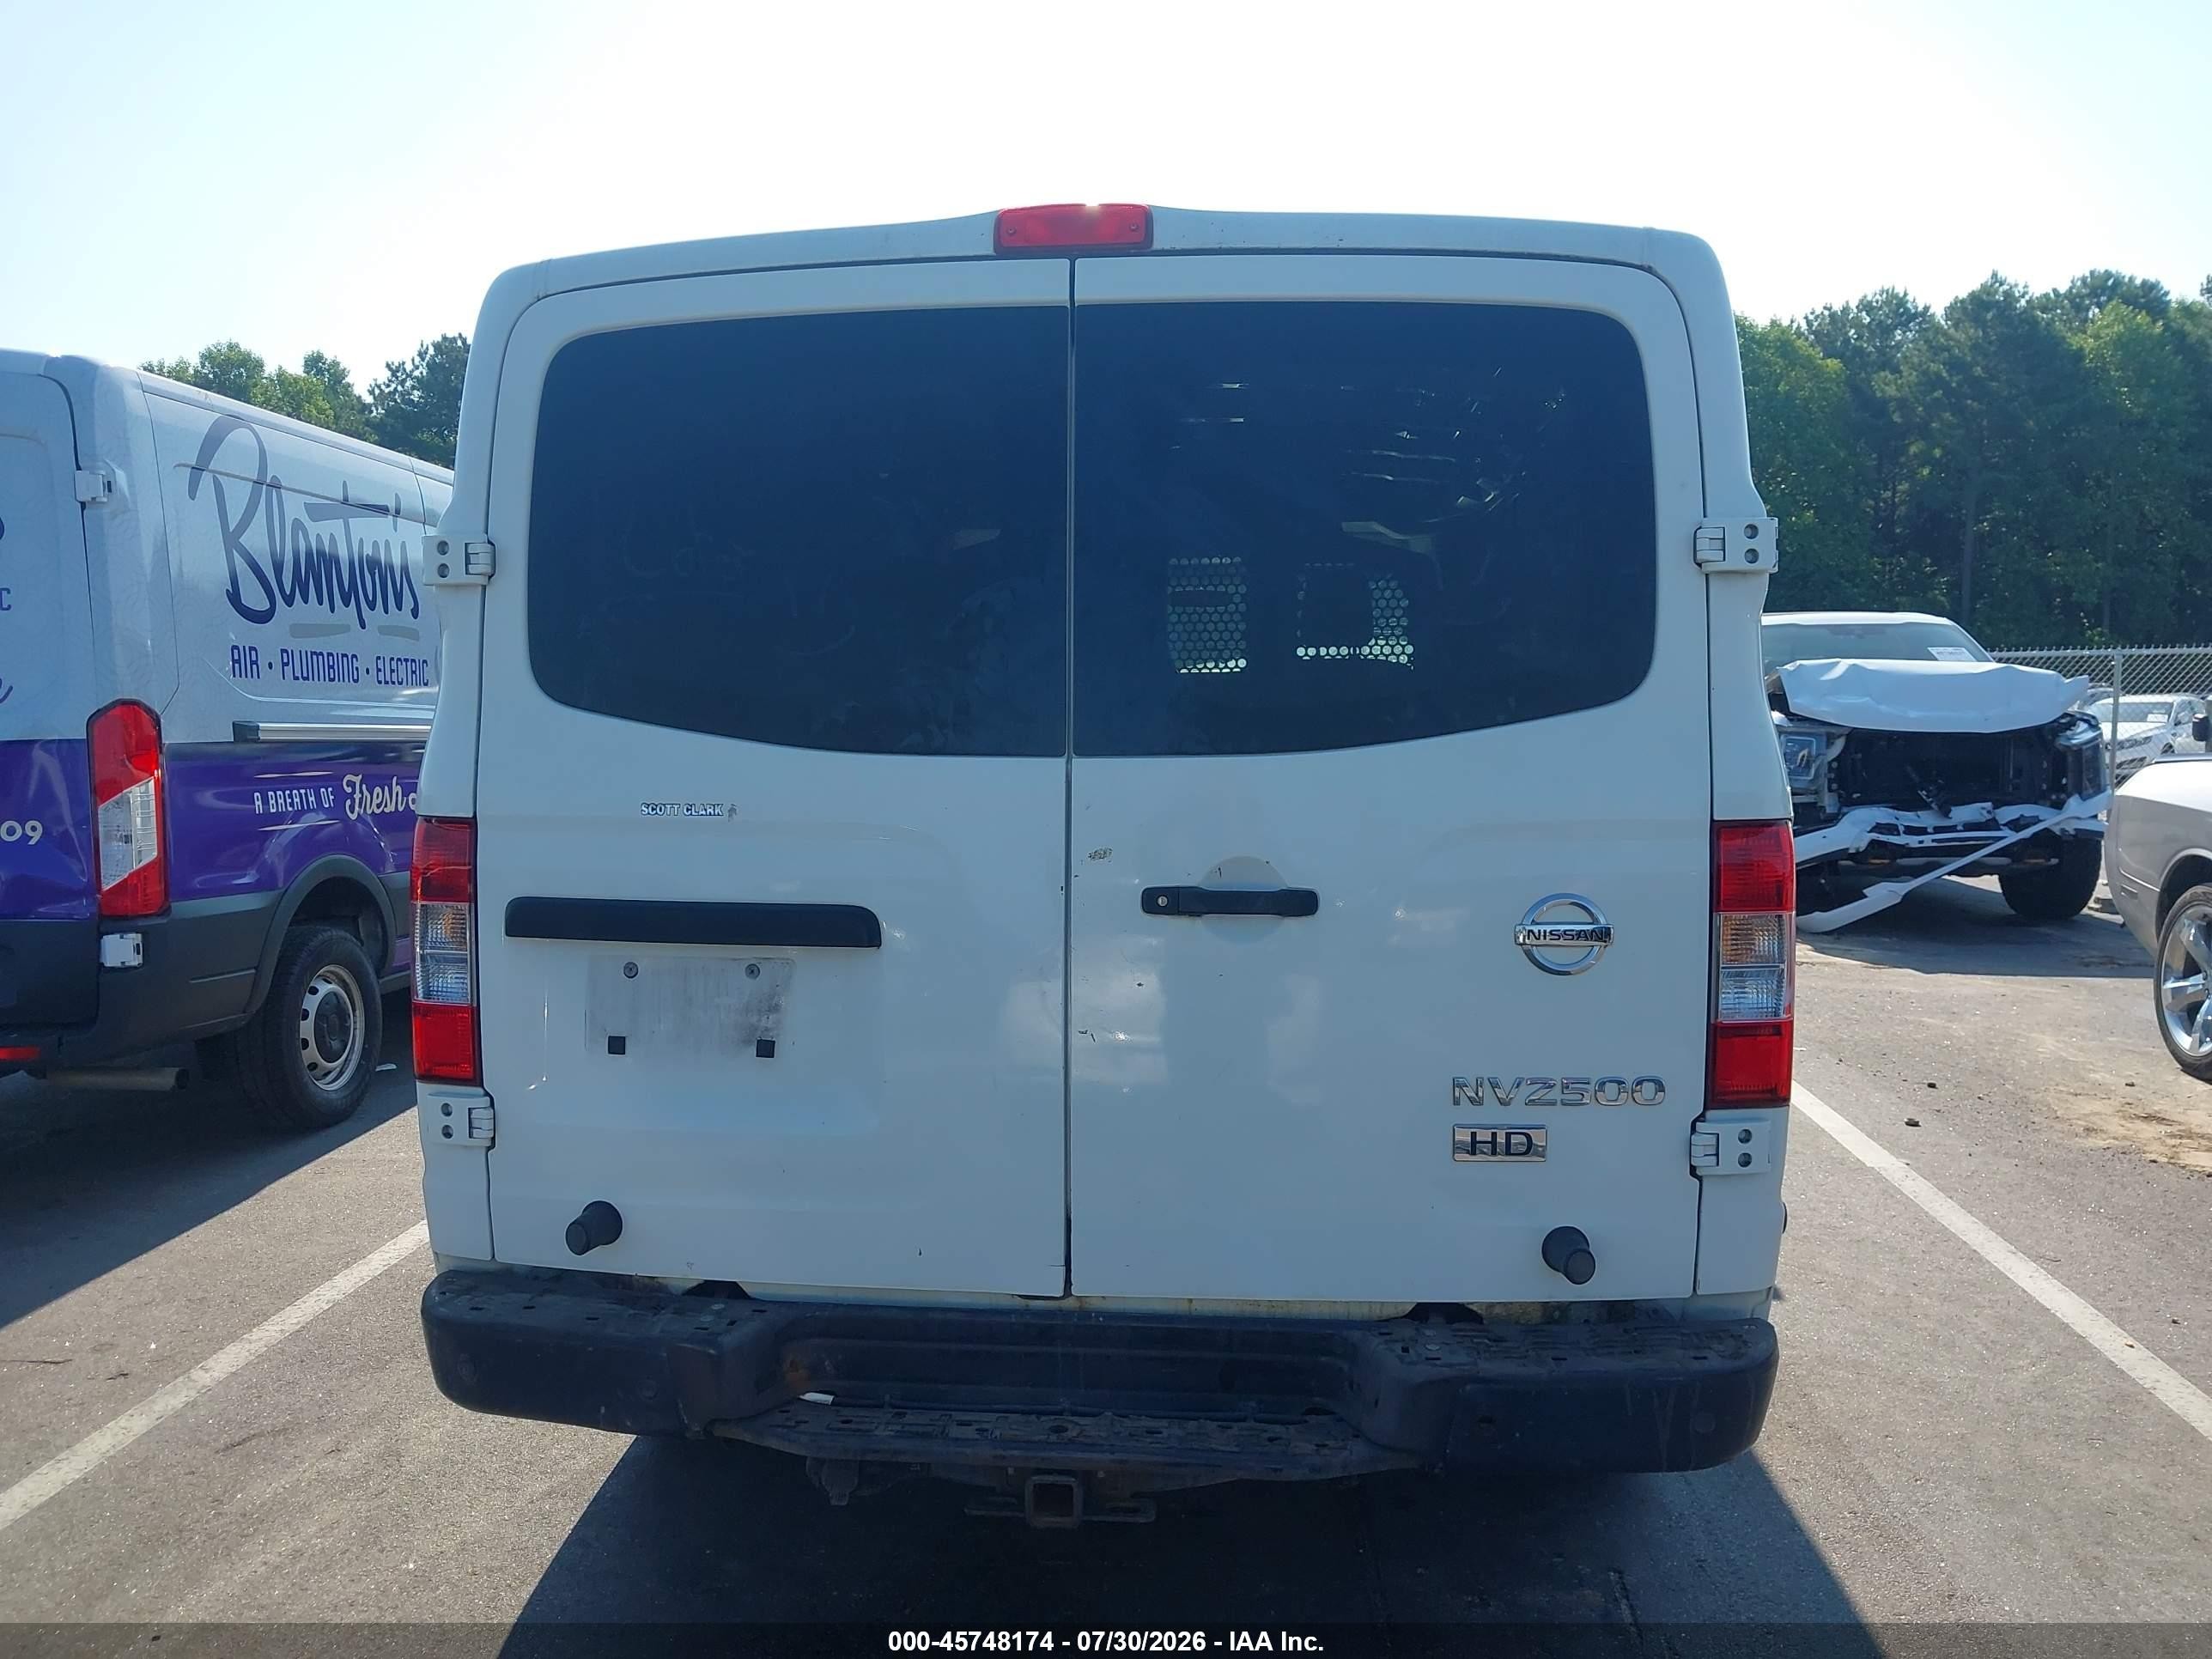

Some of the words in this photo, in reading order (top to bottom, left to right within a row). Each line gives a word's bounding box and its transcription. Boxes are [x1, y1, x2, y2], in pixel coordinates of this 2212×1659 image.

[188, 414, 420, 629] Blanton's
[231, 645, 260, 679] AIR
[280, 647, 359, 684] PLUMBING
[375, 655, 428, 687] ELECTRIC
[254, 793, 263, 814] A
[269, 788, 317, 813] BREATH
[320, 787, 335, 808] OF
[343, 774, 407, 819] Fresh
[641, 802, 680, 817] SCOTT
[683, 803, 724, 817] CLARK
[1527, 928, 1605, 941] NISSAN
[1453, 1077, 1666, 1107] NV2500
[1470, 1131, 1534, 1157] HD
